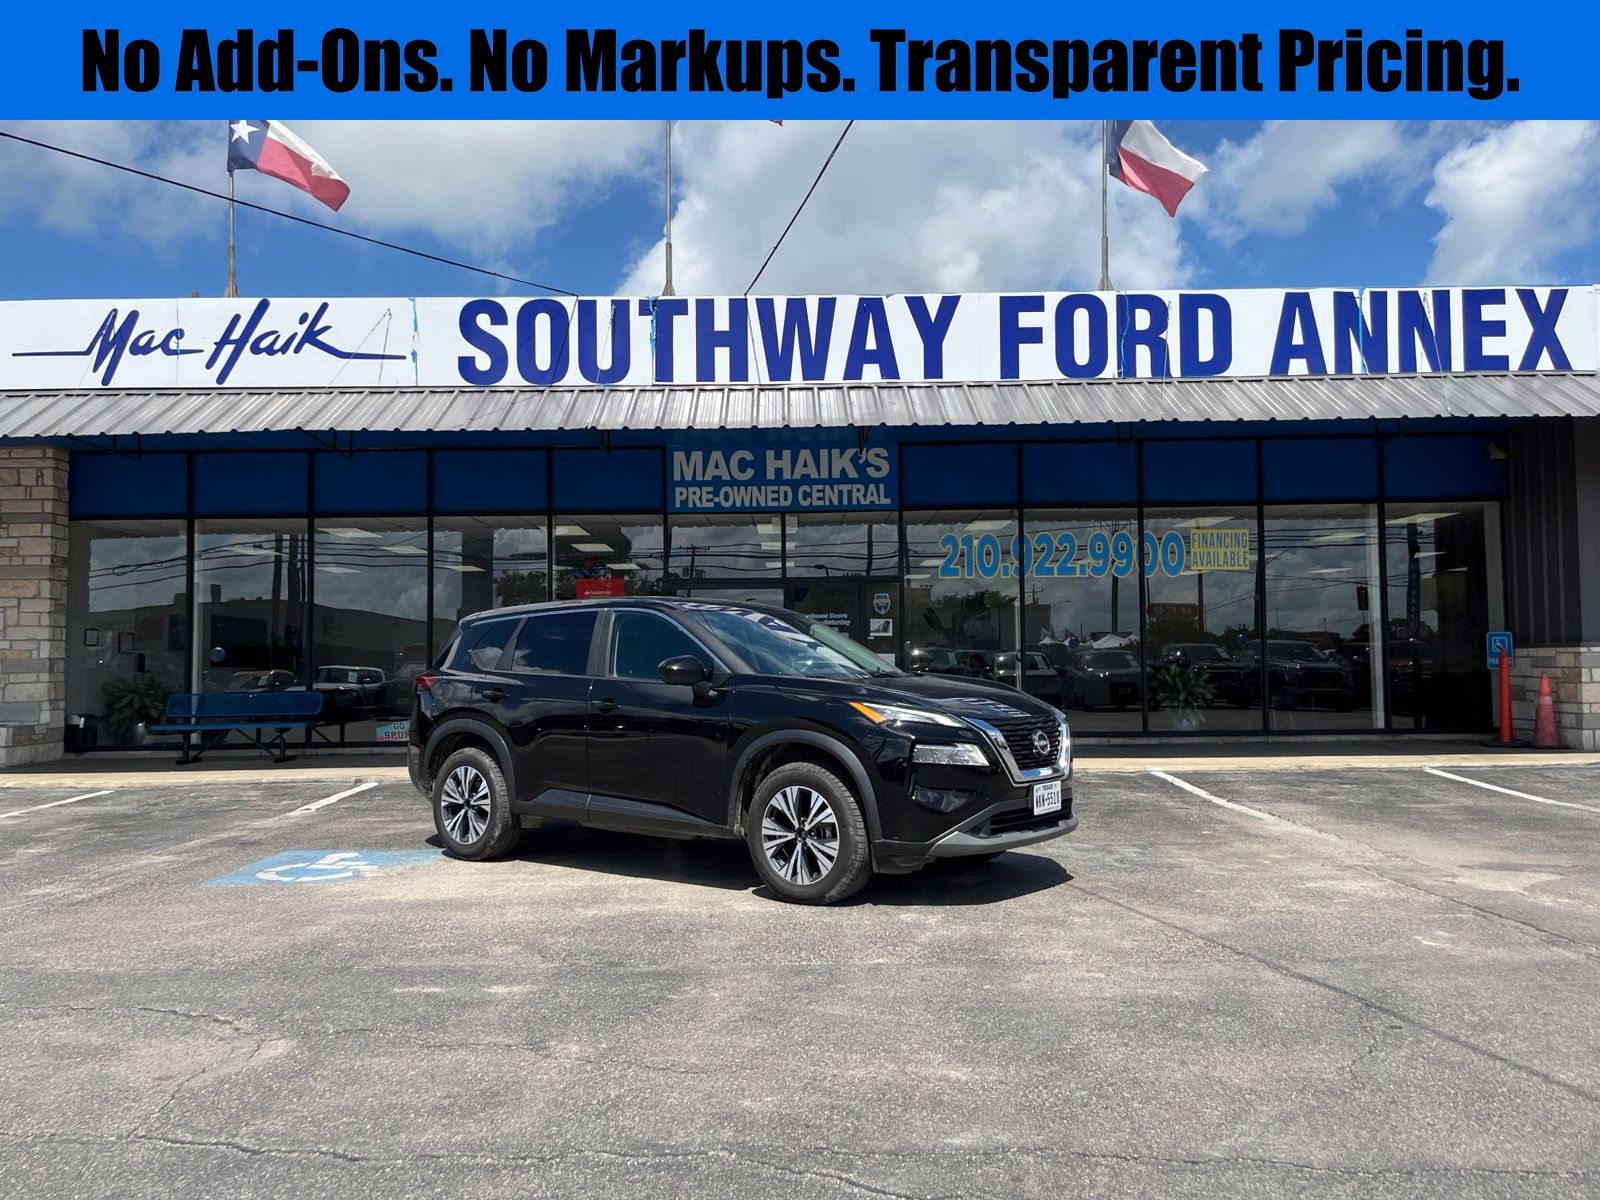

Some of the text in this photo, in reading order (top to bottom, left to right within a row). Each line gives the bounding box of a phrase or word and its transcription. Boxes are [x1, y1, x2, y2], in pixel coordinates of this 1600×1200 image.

[12, 298, 407, 386] Mac Haik
[457, 288, 1573, 385] SOUTHWAY FORD ANNEX
[673, 448, 890, 481] MAC HAIK'S
[675, 484, 892, 508] PRE-OWNED CENTRAL
[938, 531, 1185, 578] 210.922.9900
[1192, 532, 1247, 549] FINANCING
[1192, 551, 1248, 567] AVAILABLE
[393, 722, 405, 730] GO
